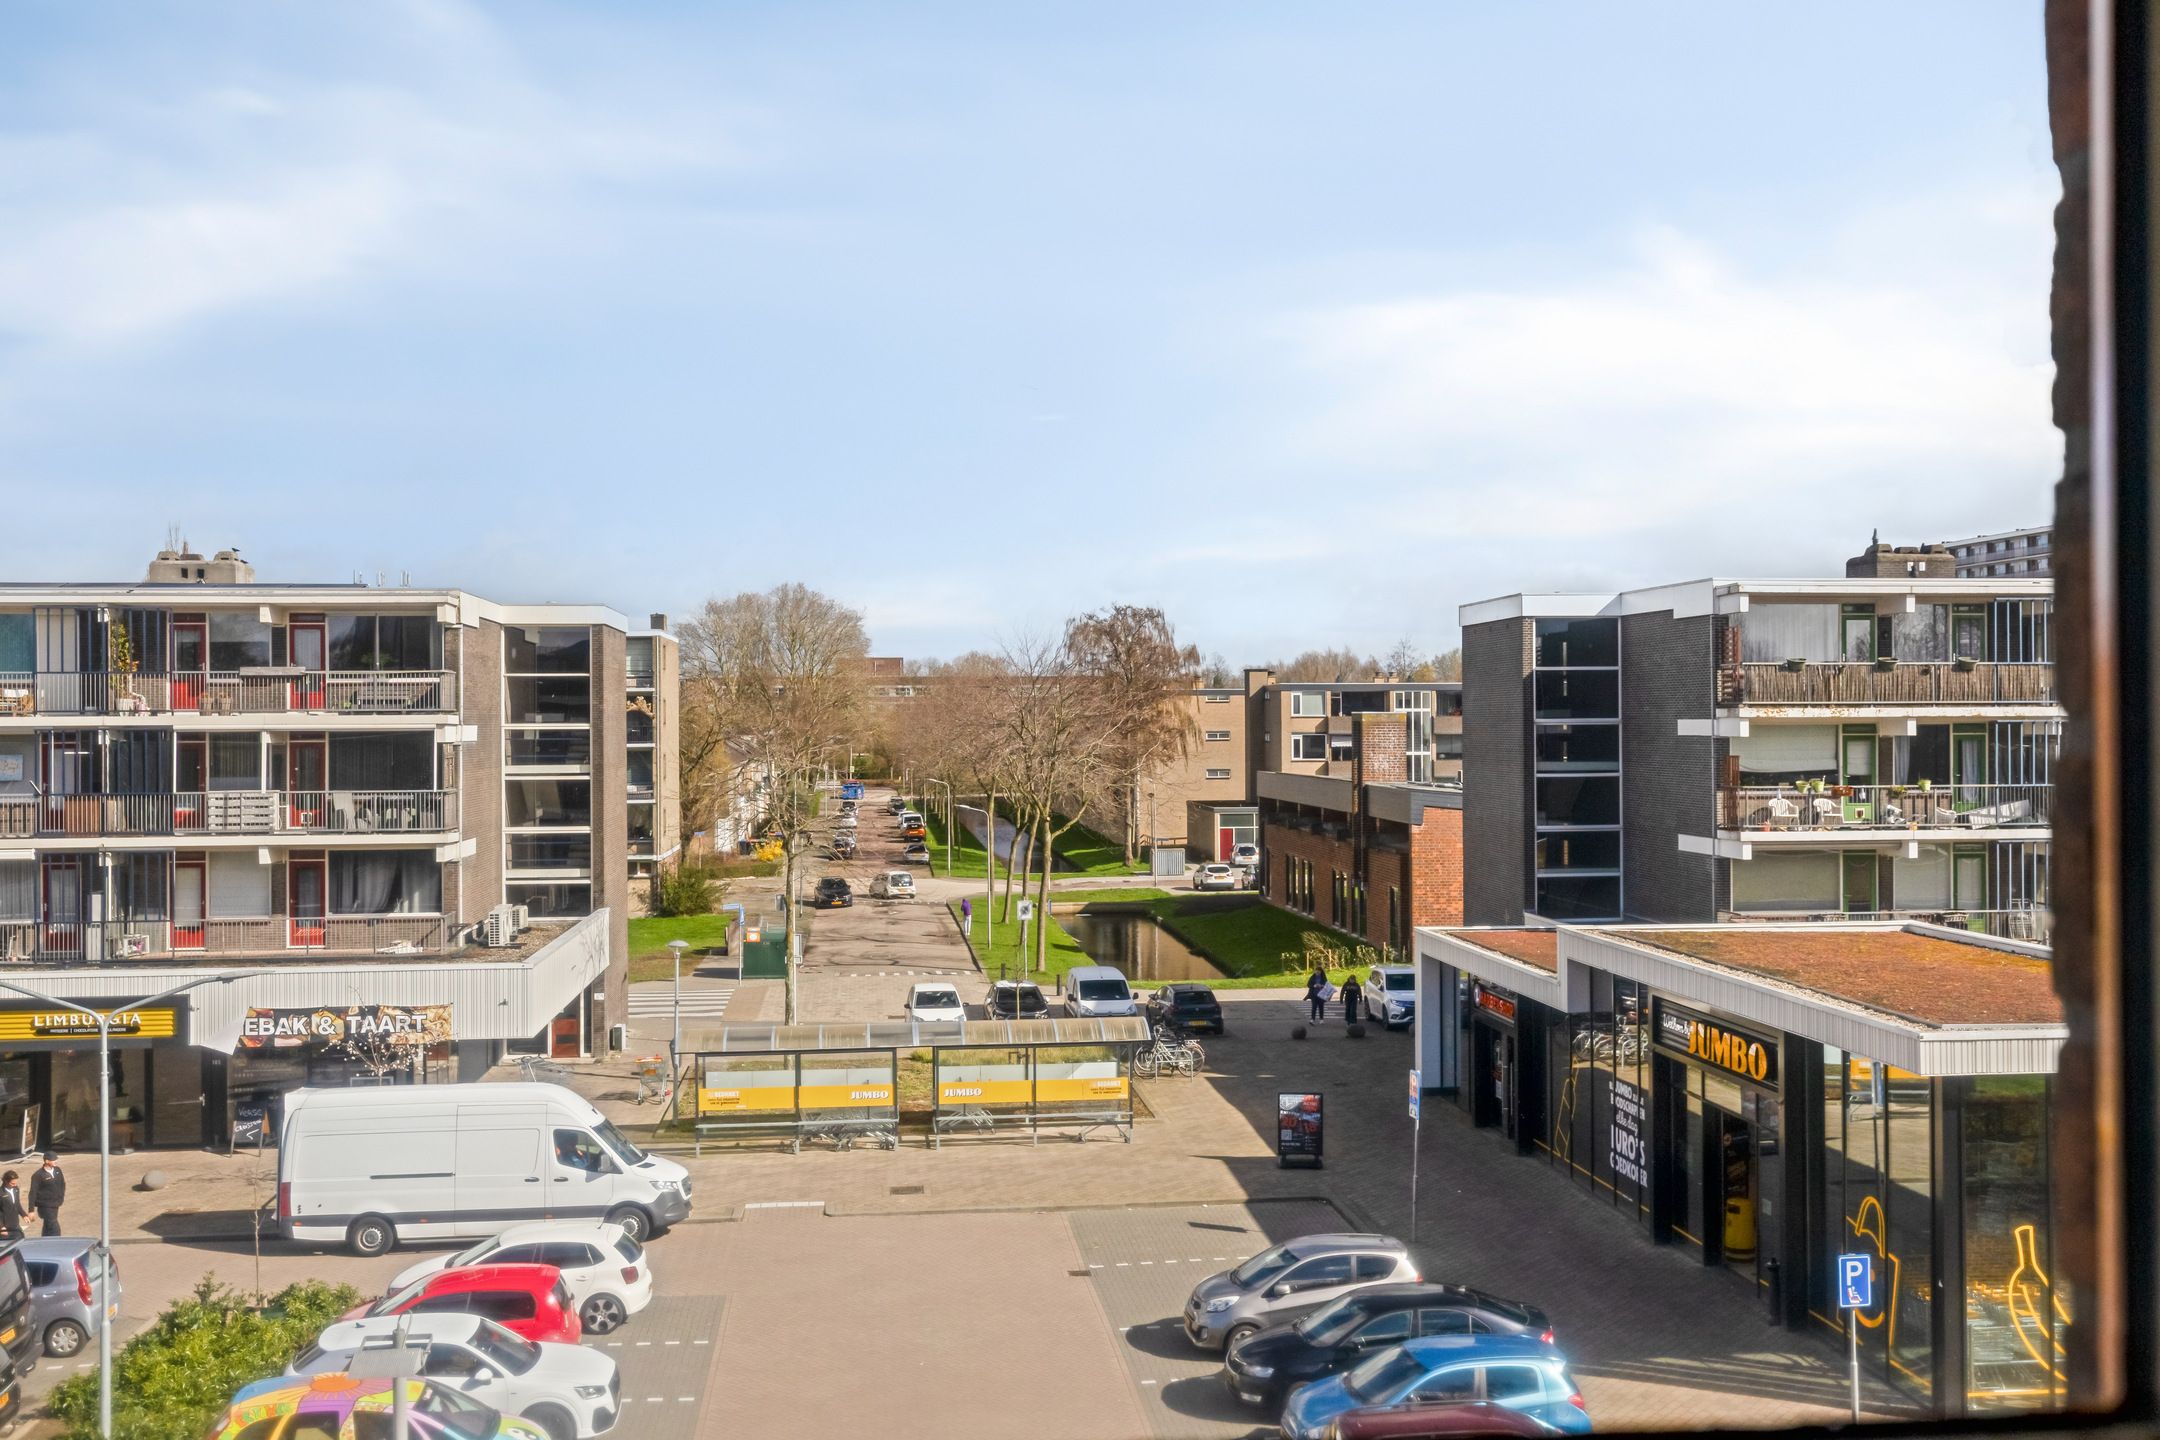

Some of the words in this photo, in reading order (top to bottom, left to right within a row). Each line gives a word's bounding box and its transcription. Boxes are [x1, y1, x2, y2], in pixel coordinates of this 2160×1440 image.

[318, 1016, 336, 1035] &
[346, 1014, 427, 1034] TAART
[1688, 1019, 1767, 1080] JUMBO
[851, 1090, 889, 1099] JUMBO
[943, 1088, 982, 1097] JUMBO
[1846, 1261, 1863, 1286] P
